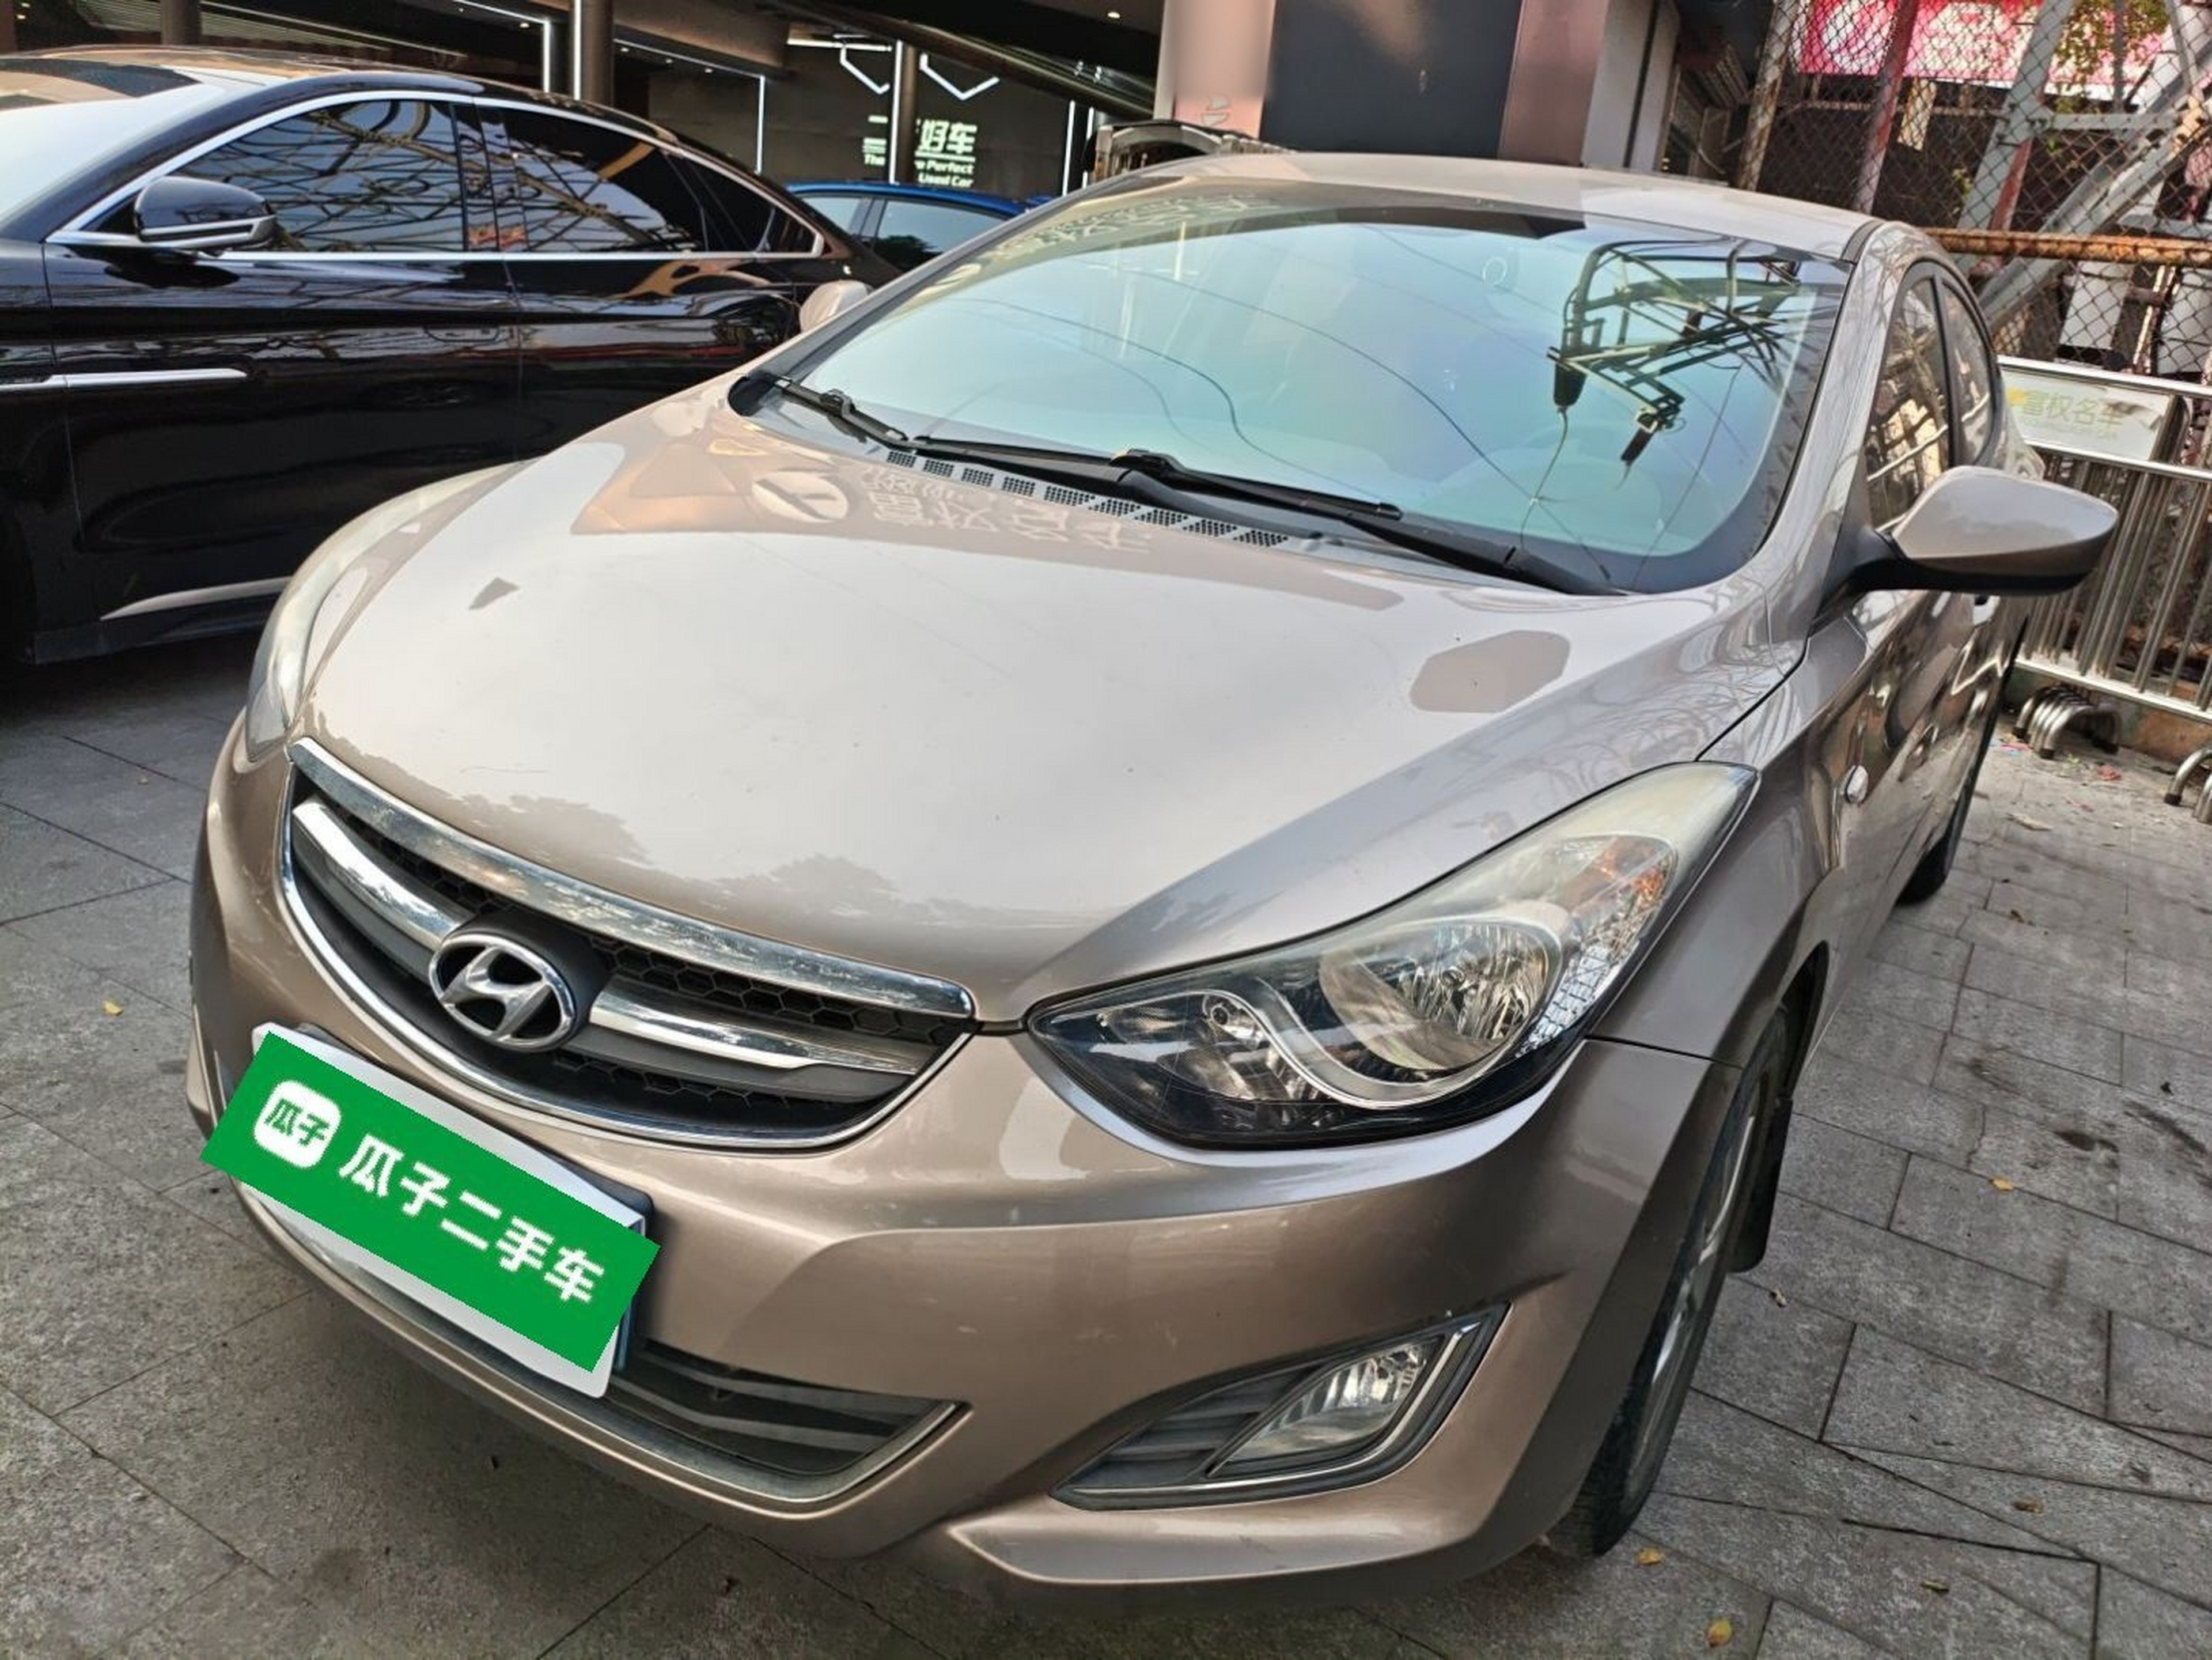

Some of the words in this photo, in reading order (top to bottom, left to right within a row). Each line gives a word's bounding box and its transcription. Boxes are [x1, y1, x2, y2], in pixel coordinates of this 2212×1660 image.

[927, 160, 974, 175] Perfect
[919, 172, 950, 186] Used
[951, 175, 974, 188] Car
